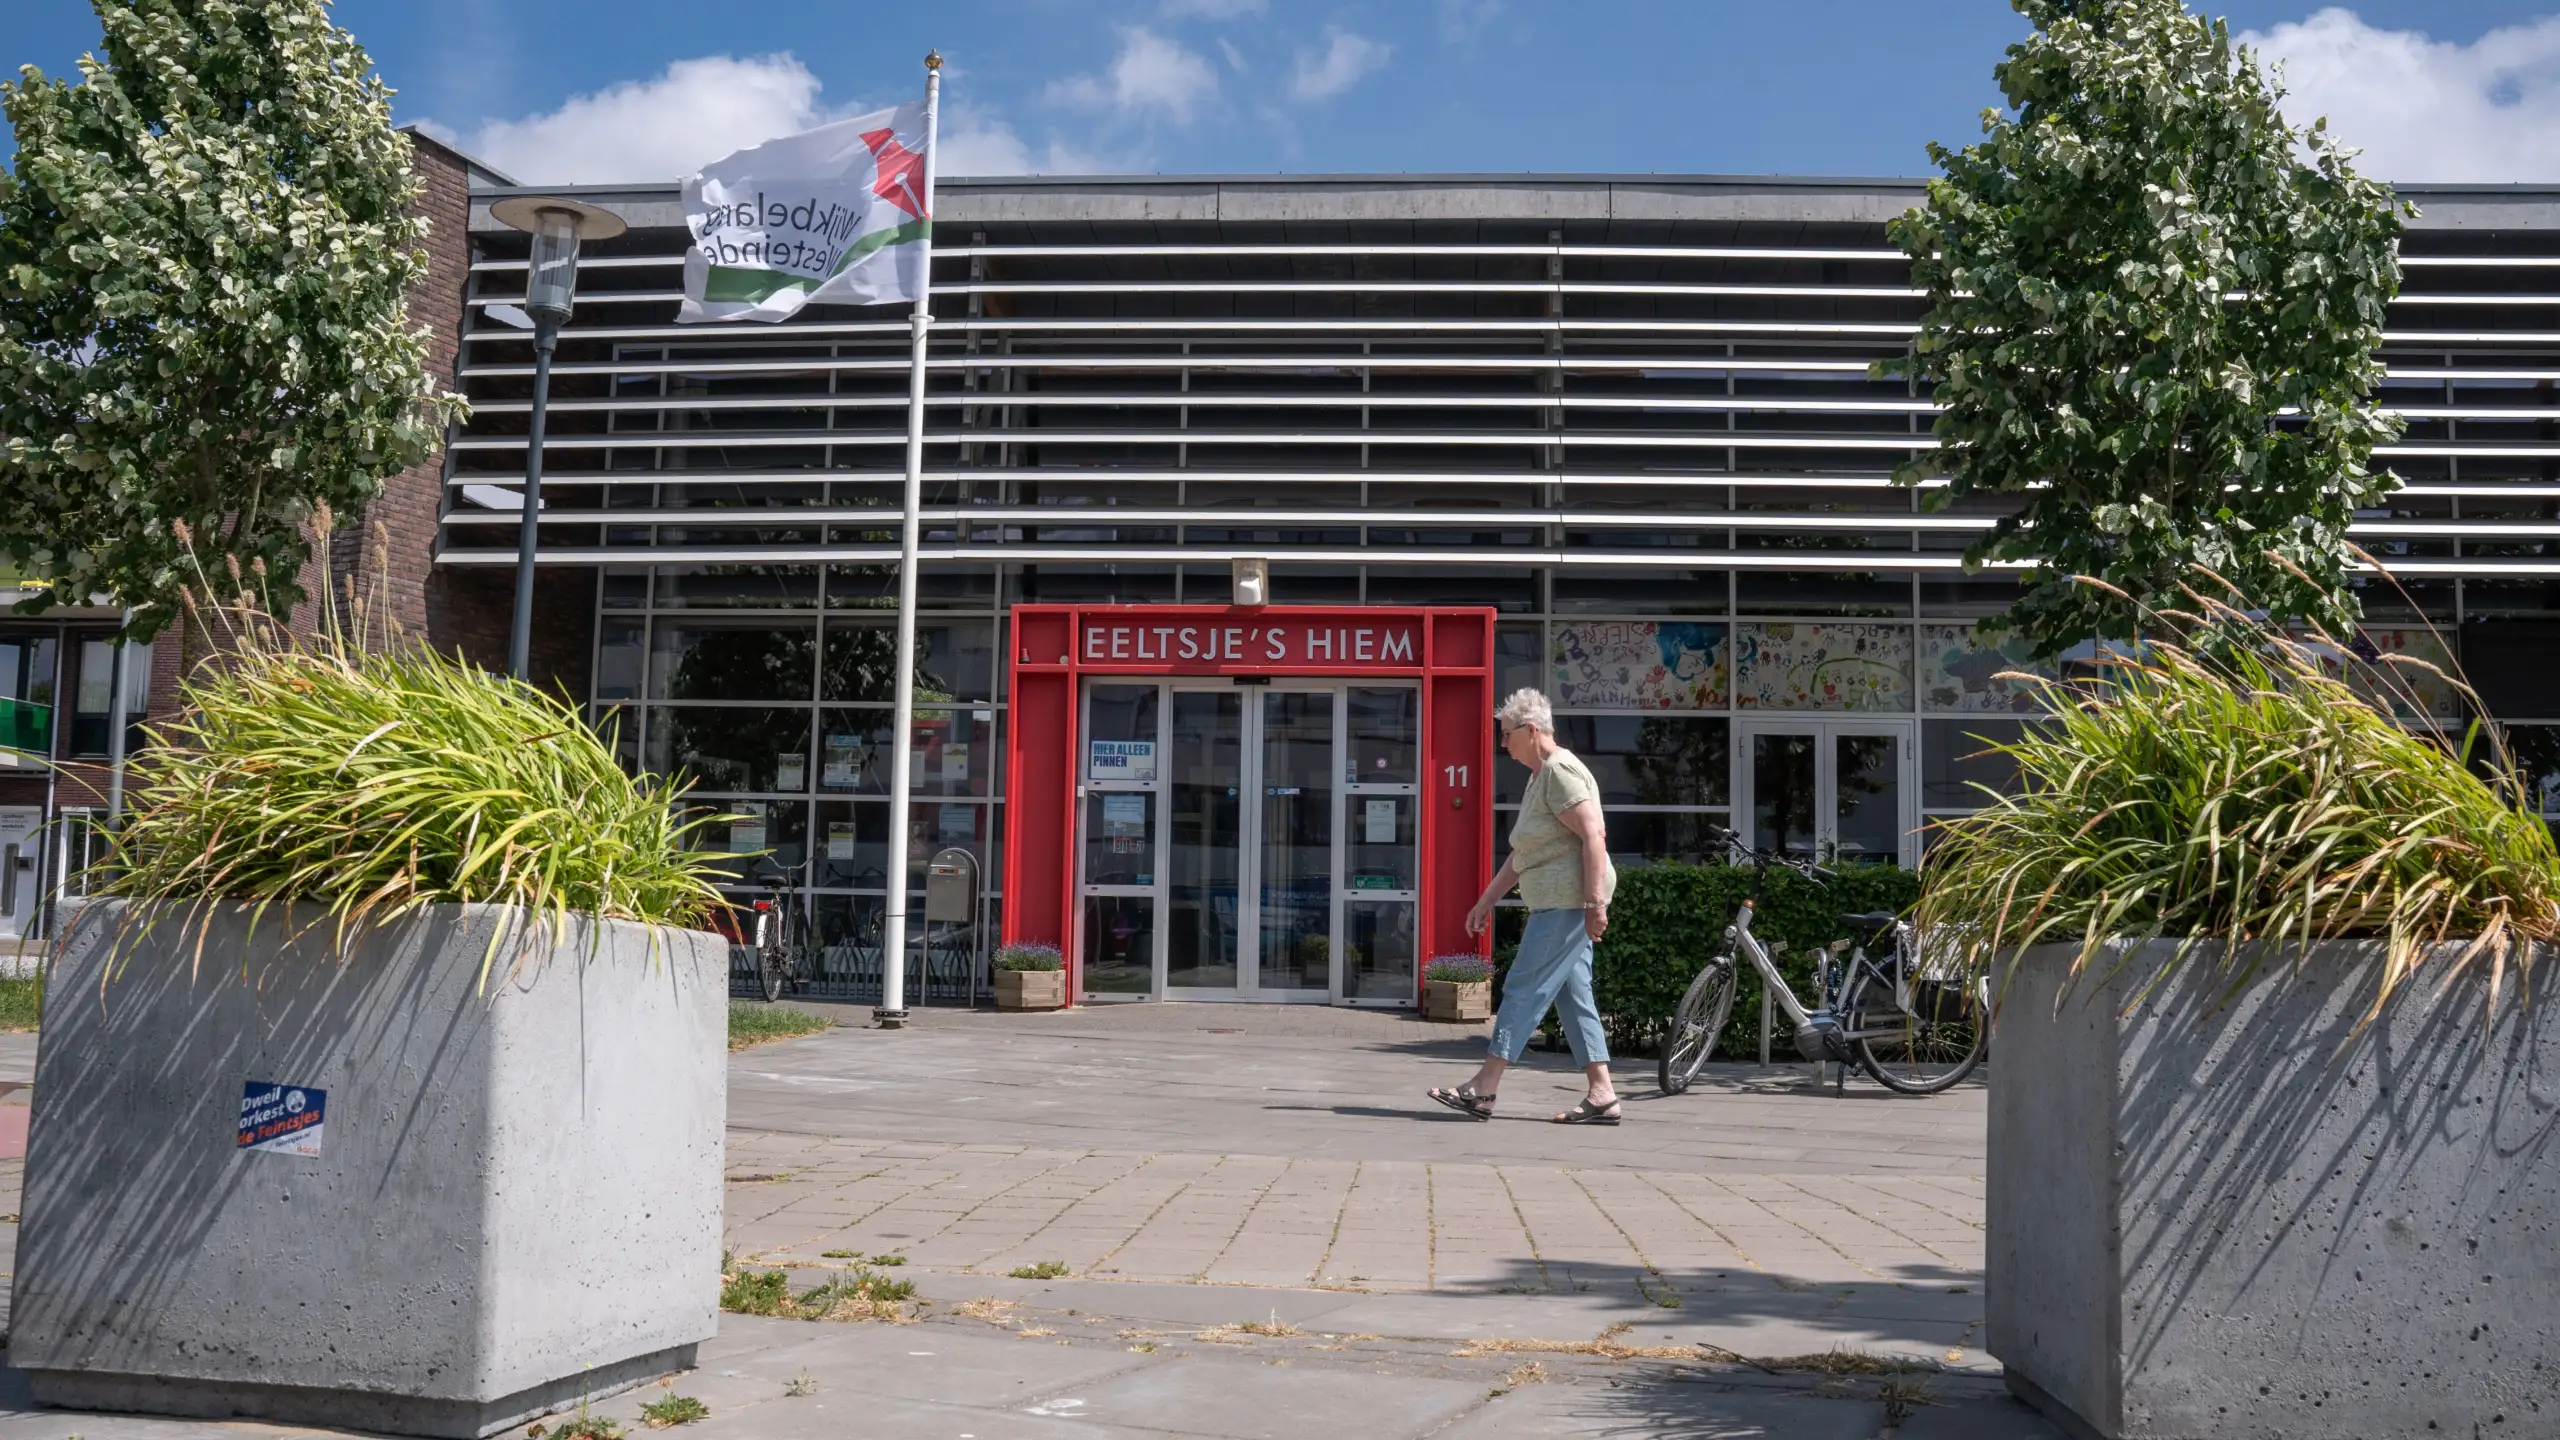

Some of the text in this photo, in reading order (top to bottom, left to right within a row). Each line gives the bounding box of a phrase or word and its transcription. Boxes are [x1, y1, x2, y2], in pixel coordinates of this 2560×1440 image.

[1086, 627, 1413, 661] EELTSJE'S HIEM
[1093, 743, 1151, 756] HIER ALLEEN
[1093, 755, 1127, 767] PINNEN
[1444, 765, 1468, 788] 11
[241, 1086, 282, 1112] Dweil
[238, 1109, 320, 1144] de Feintsjes
[239, 1103, 285, 1129] orkest
